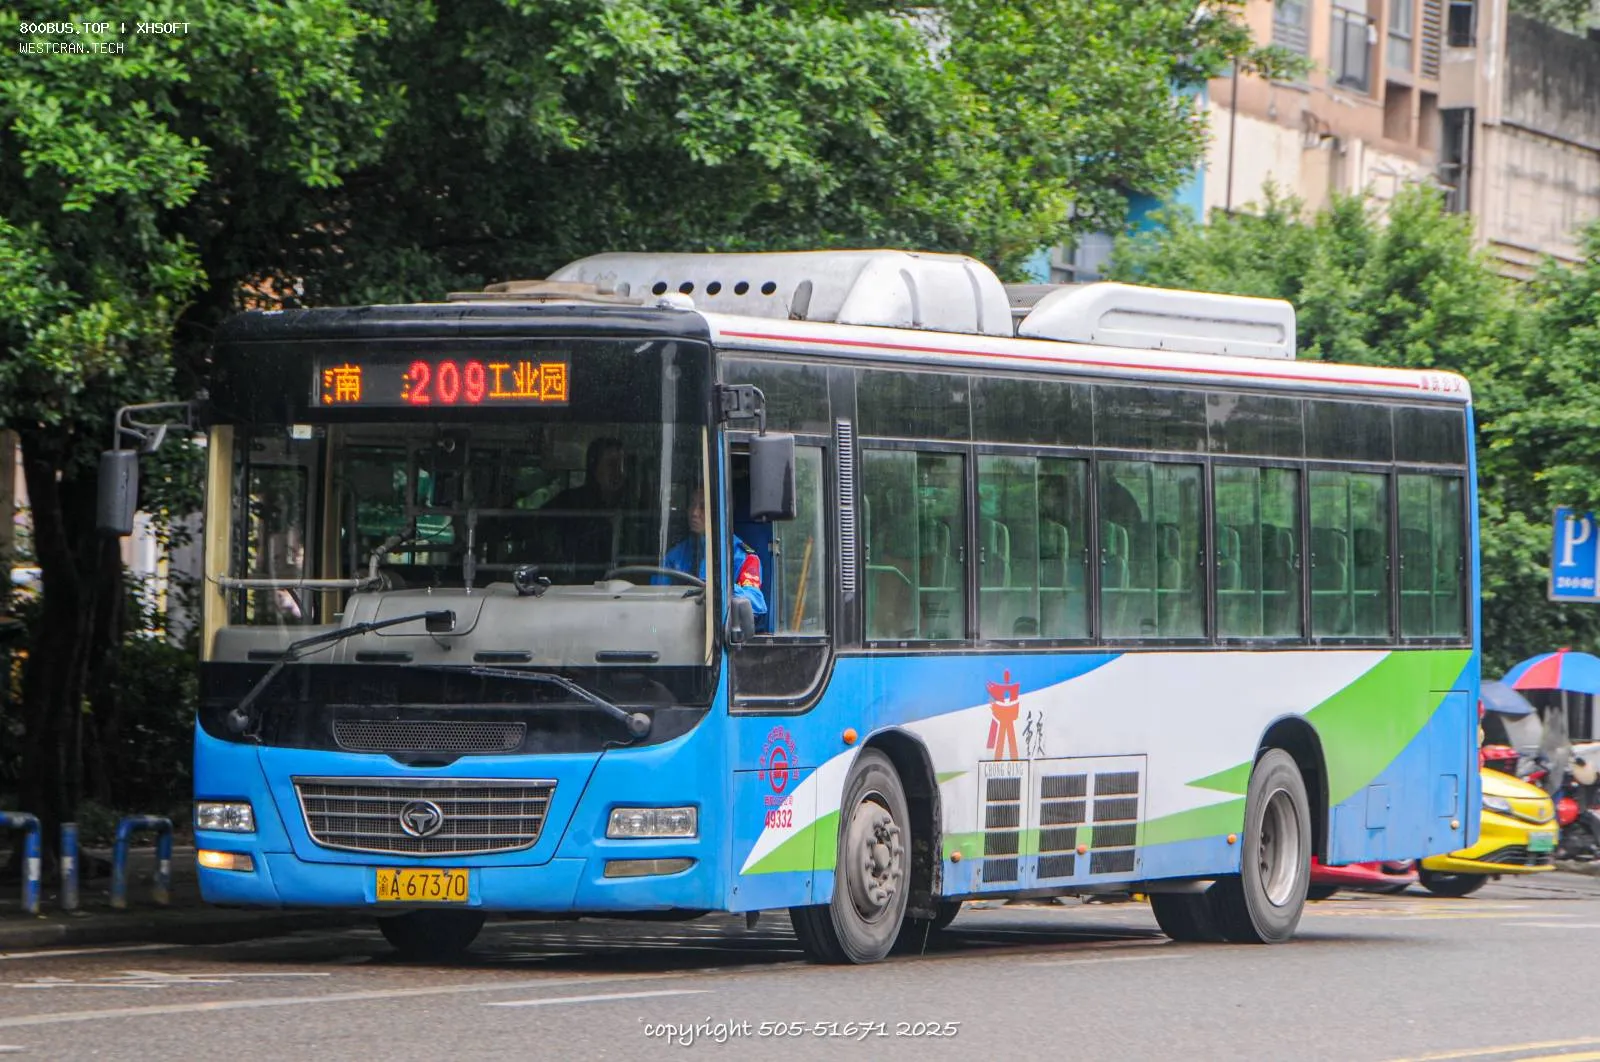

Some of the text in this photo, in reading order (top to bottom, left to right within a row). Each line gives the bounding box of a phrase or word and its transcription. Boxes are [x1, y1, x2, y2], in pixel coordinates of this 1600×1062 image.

[408, 360, 487, 402] 209
[488, 361, 568, 402] 工业园
[1560, 514, 1591, 567] P
[765, 809, 793, 829] 49332
